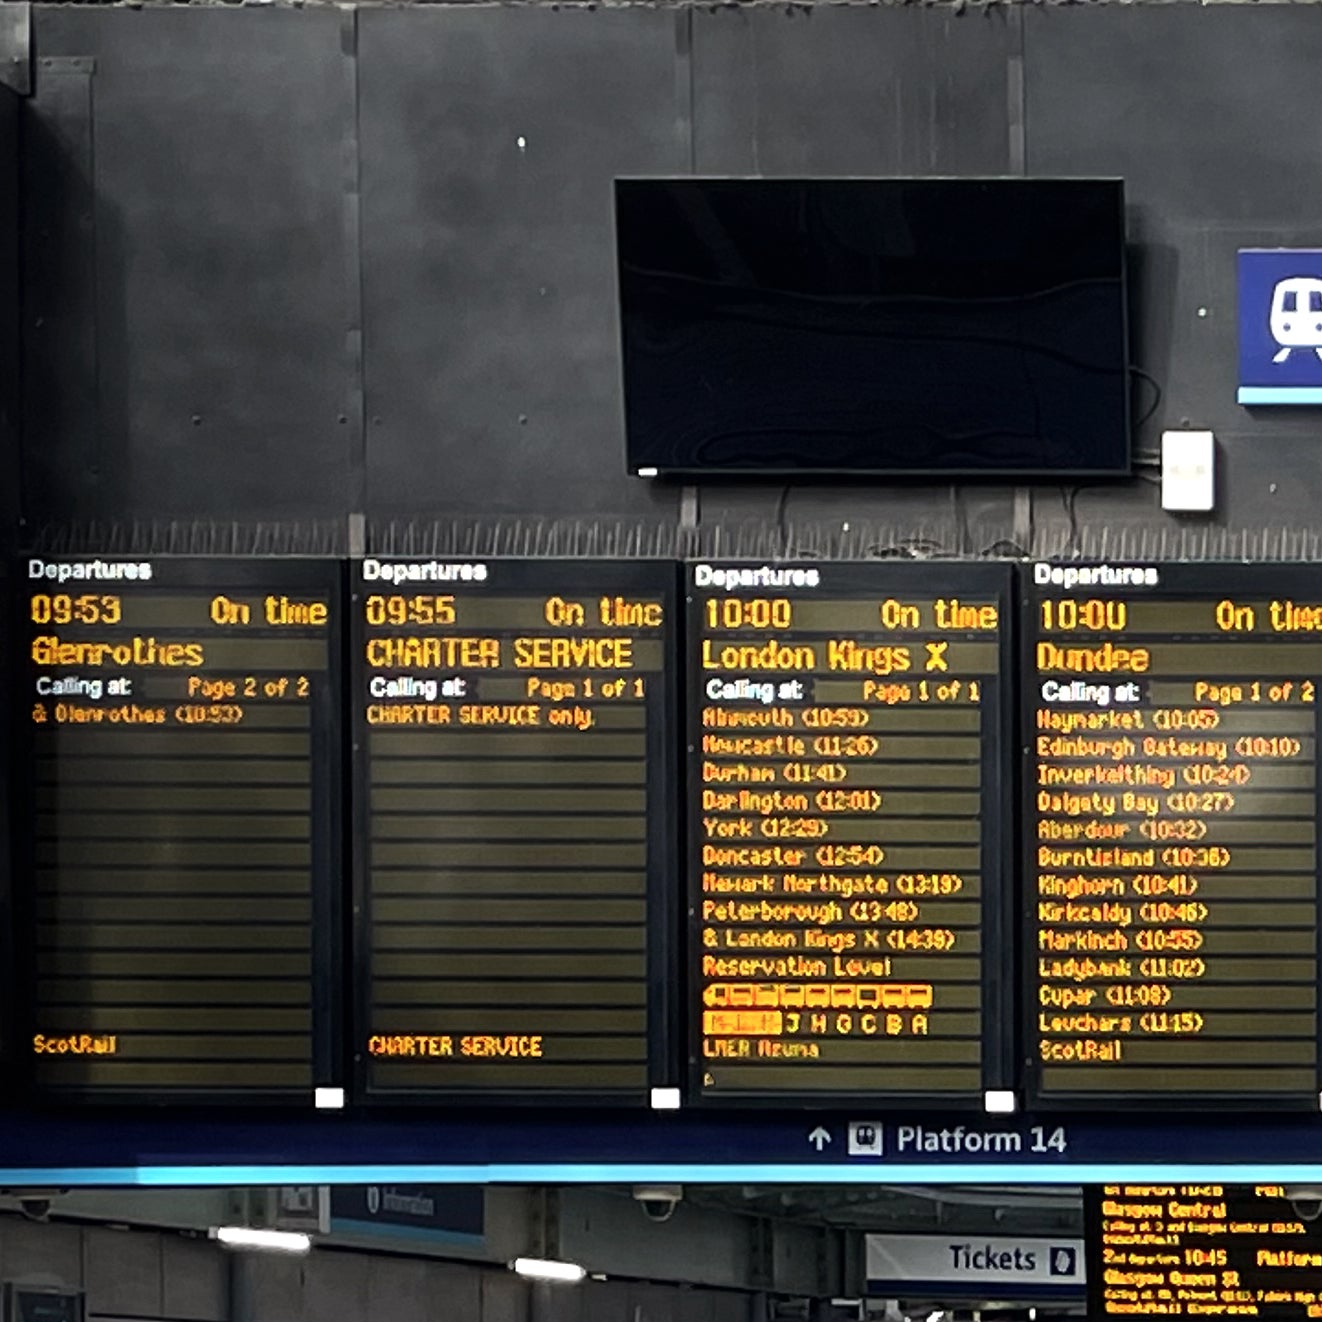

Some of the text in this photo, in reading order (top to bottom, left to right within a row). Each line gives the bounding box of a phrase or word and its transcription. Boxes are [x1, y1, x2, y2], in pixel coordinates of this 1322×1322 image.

[28, 559, 153, 583] Departures
[363, 559, 488, 585] Departures
[695, 564, 820, 591] Departures
[1034, 562, 1159, 590] Departures
[31, 594, 328, 625] 09:53 On time
[366, 595, 663, 628] 09:55 On time
[881, 599, 920, 630] On
[933, 599, 999, 629] time
[366, 637, 633, 668] CHARTER SERVICE
[702, 639, 948, 676] London Kings X
[898, 1126, 1067, 1153] Platform 14
[948, 1242, 1036, 1271] Tickets
